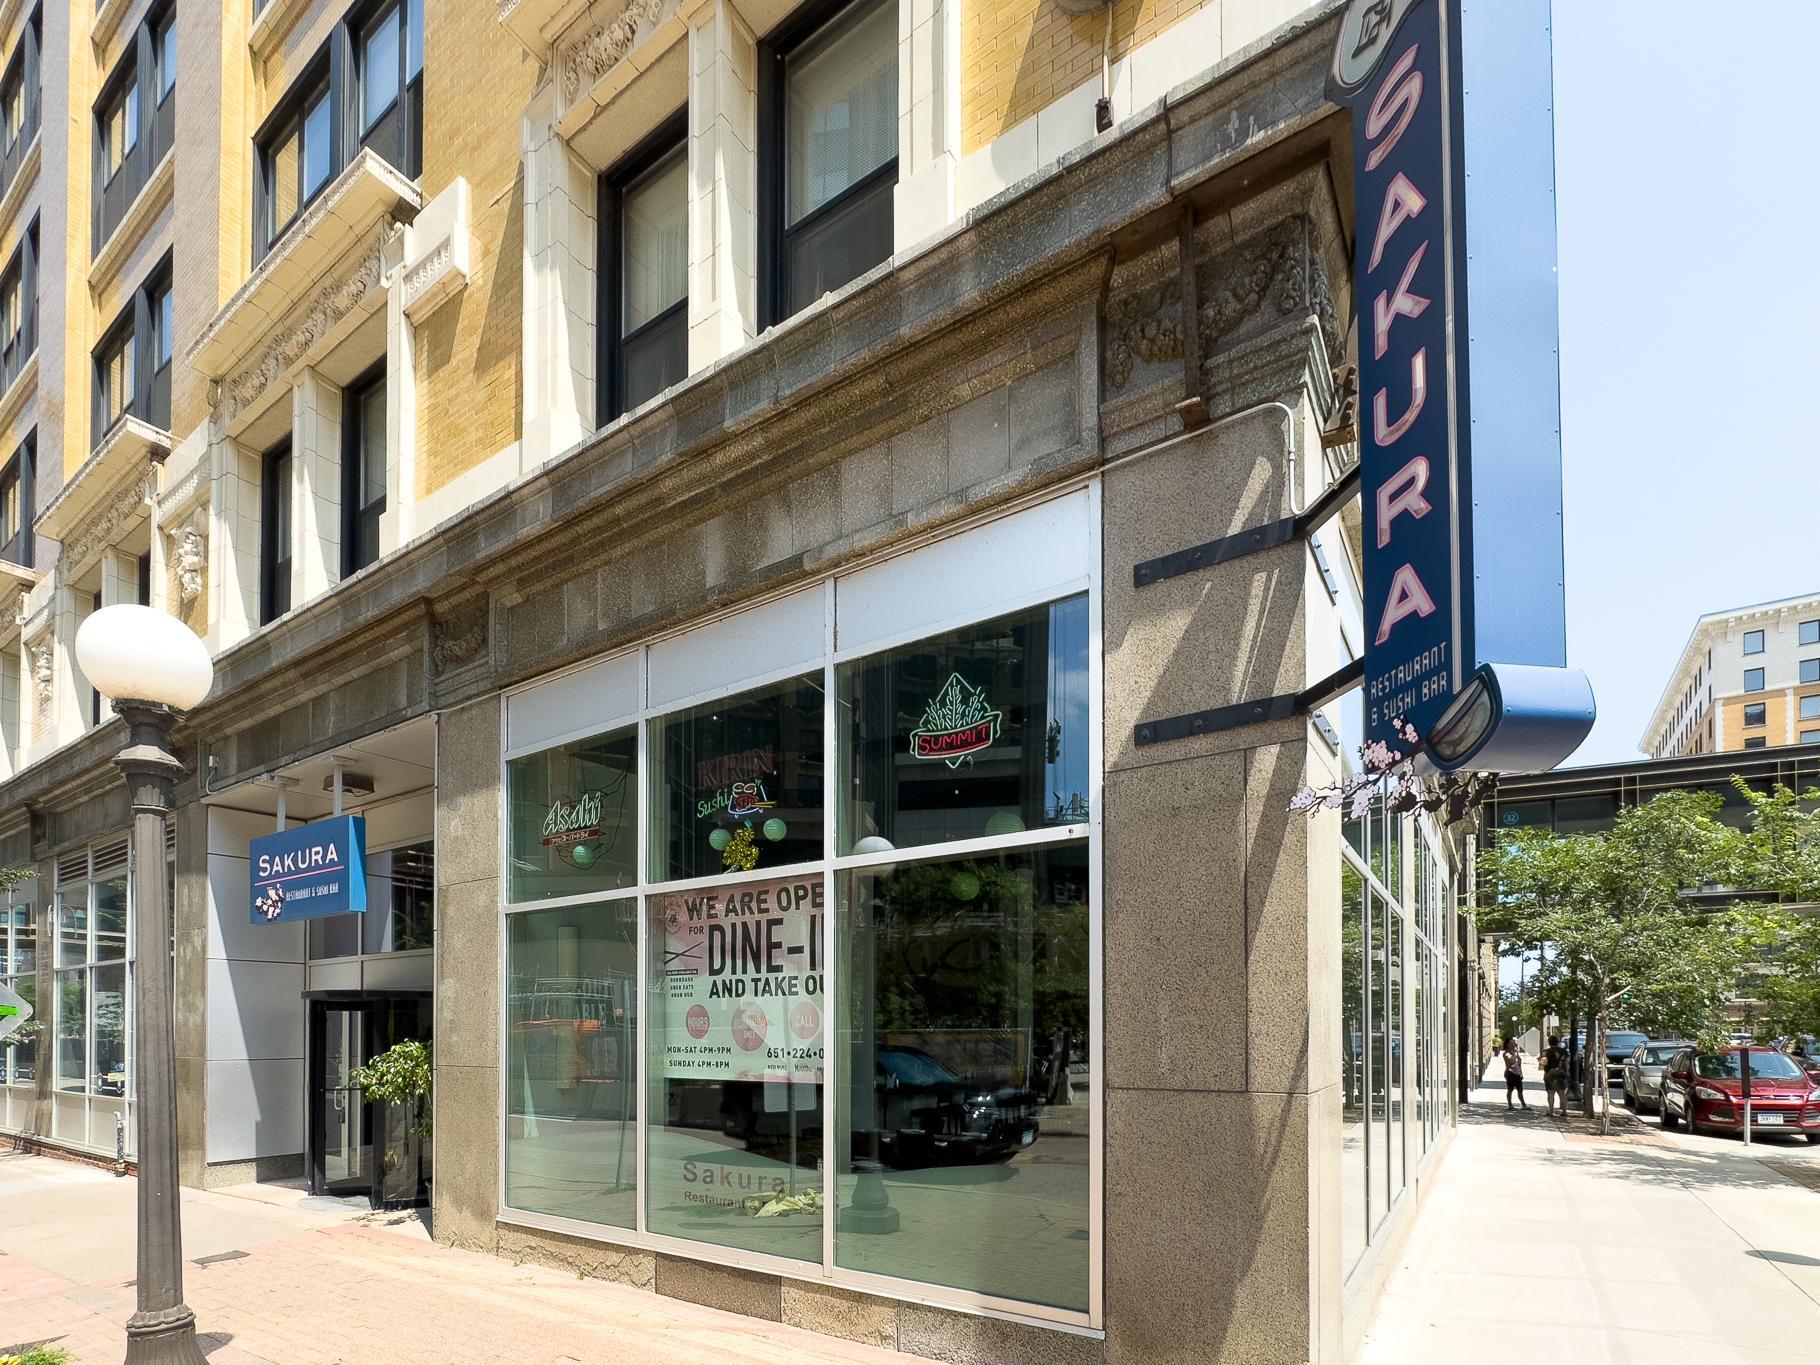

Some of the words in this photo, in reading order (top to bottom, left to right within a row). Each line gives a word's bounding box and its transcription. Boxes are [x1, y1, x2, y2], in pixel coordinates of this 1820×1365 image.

[1364, 42, 1437, 646] SAKURA
[1370, 641, 1446, 700] RESTAURANT
[1383, 687, 1416, 720] SUSHI
[1422, 671, 1447, 702] BAR
[918, 722, 990, 755] SUMMIT
[698, 745, 773, 789] KIRIN
[542, 791, 601, 835] Asahi
[697, 788, 730, 818] Sushi
[259, 843, 338, 877] SAKURA
[684, 895, 720, 921] WE
[724, 889, 770, 917] ARE
[689, 926, 705, 935] FOR
[708, 913, 824, 976] DINE-I
[709, 978, 746, 998] AND
[751, 976, 799, 998] TAKE
[688, 1016, 709, 1027] HOURS
[796, 1016, 814, 1027] CALL
[667, 1046, 697, 1054] MON-SAT
[699, 1046, 732, 1054] 4PM-9PM
[669, 1060, 695, 1068] SUNDAY
[697, 1060, 730, 1069] 4PM-8PM
[683, 1161, 785, 1191] Sakura
[684, 1191, 745, 1209] Restaurant
